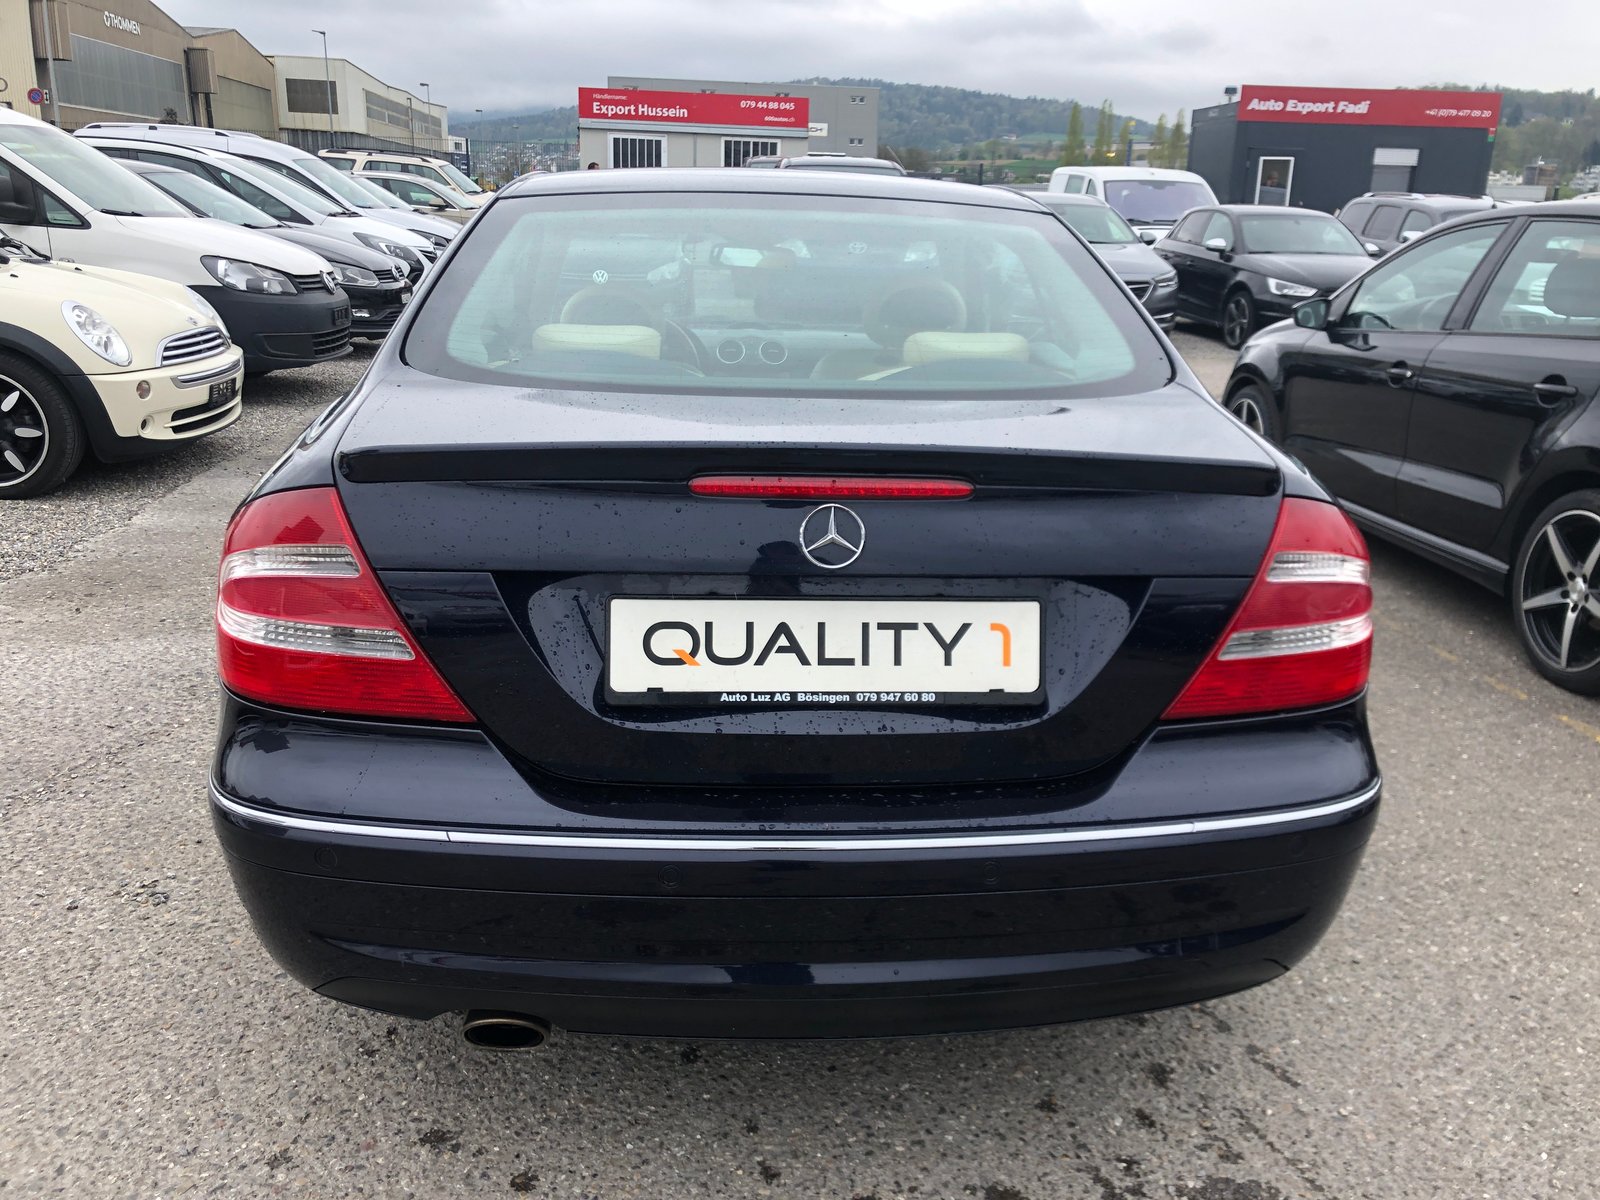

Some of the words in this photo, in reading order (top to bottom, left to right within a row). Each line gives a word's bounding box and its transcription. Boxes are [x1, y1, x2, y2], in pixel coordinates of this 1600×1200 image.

[593, 101, 636, 117] Export
[638, 103, 688, 118] Hussein
[740, 100, 756, 109] 079
[757, 101, 767, 109] 44
[768, 102, 779, 110] 88
[780, 103, 796, 111] 045
[1246, 98, 1285, 112] Auto
[1286, 99, 1336, 115] Export
[1336, 100, 1371, 114] Fadi
[1481, 110, 1492, 118] 20
[642, 621, 973, 667] QUALITY
[989, 622, 1012, 667] 1
[720, 692, 748, 702] Auto
[751, 692, 771, 702] Luz
[774, 692, 791, 702] AG
[797, 692, 850, 704] Bösingen
[856, 692, 877, 702] 079
[880, 692, 901, 702] 947
[904, 692, 918, 702] 60
[921, 692, 936, 702] 80
